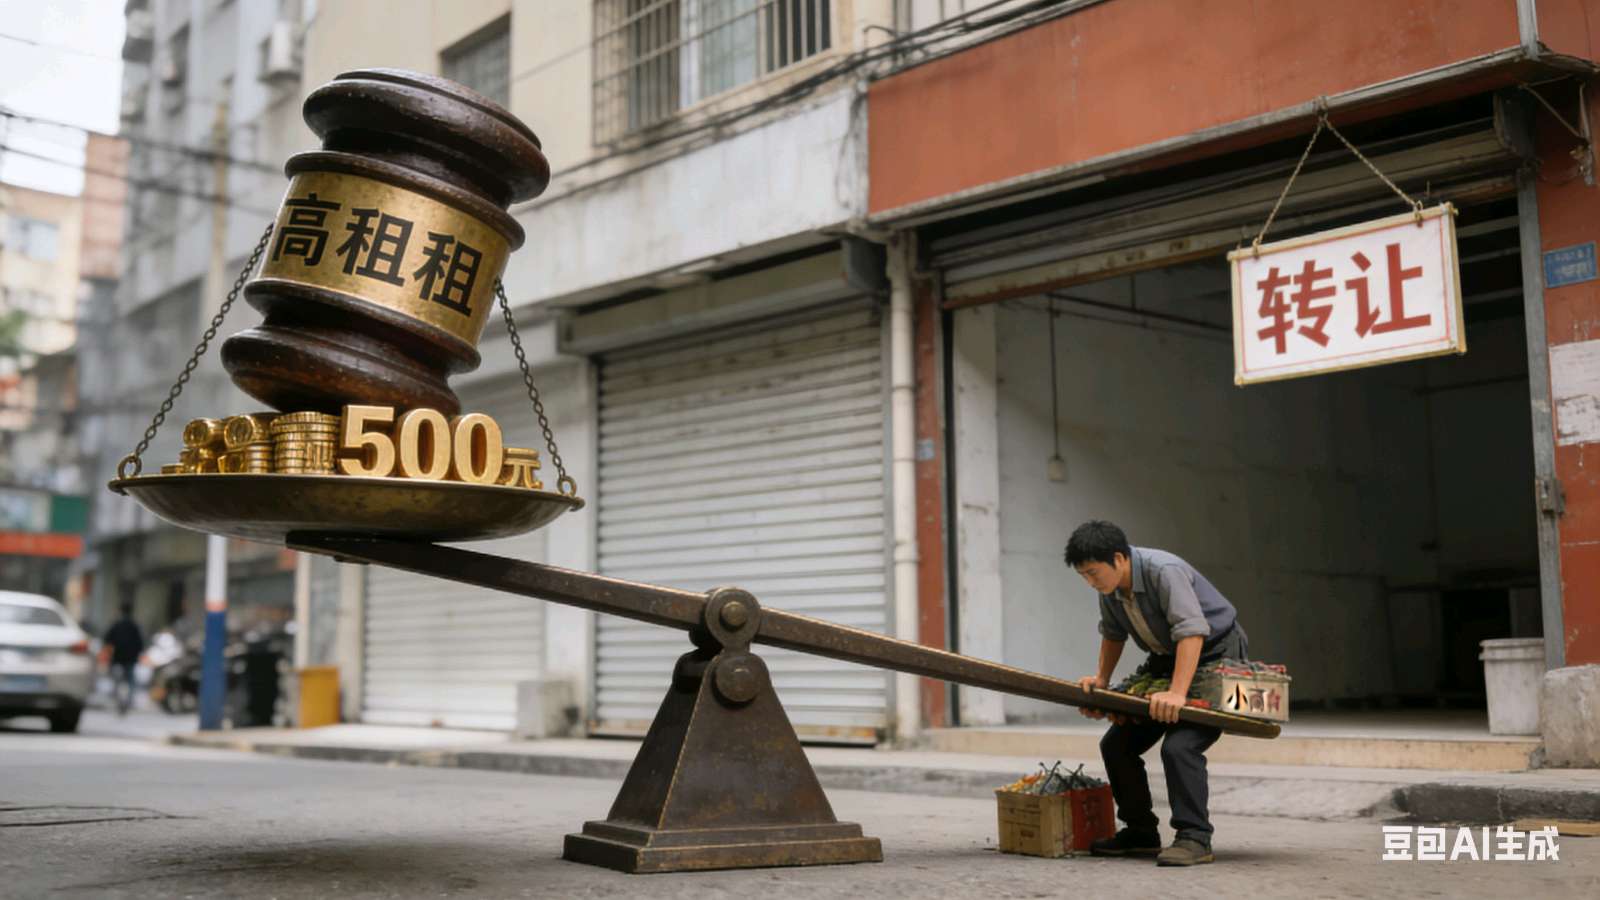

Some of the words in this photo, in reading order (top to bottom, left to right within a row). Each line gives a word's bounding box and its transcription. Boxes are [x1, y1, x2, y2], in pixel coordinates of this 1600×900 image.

[272, 193, 483, 317] 高租租
[1257, 244, 1432, 354] 转让
